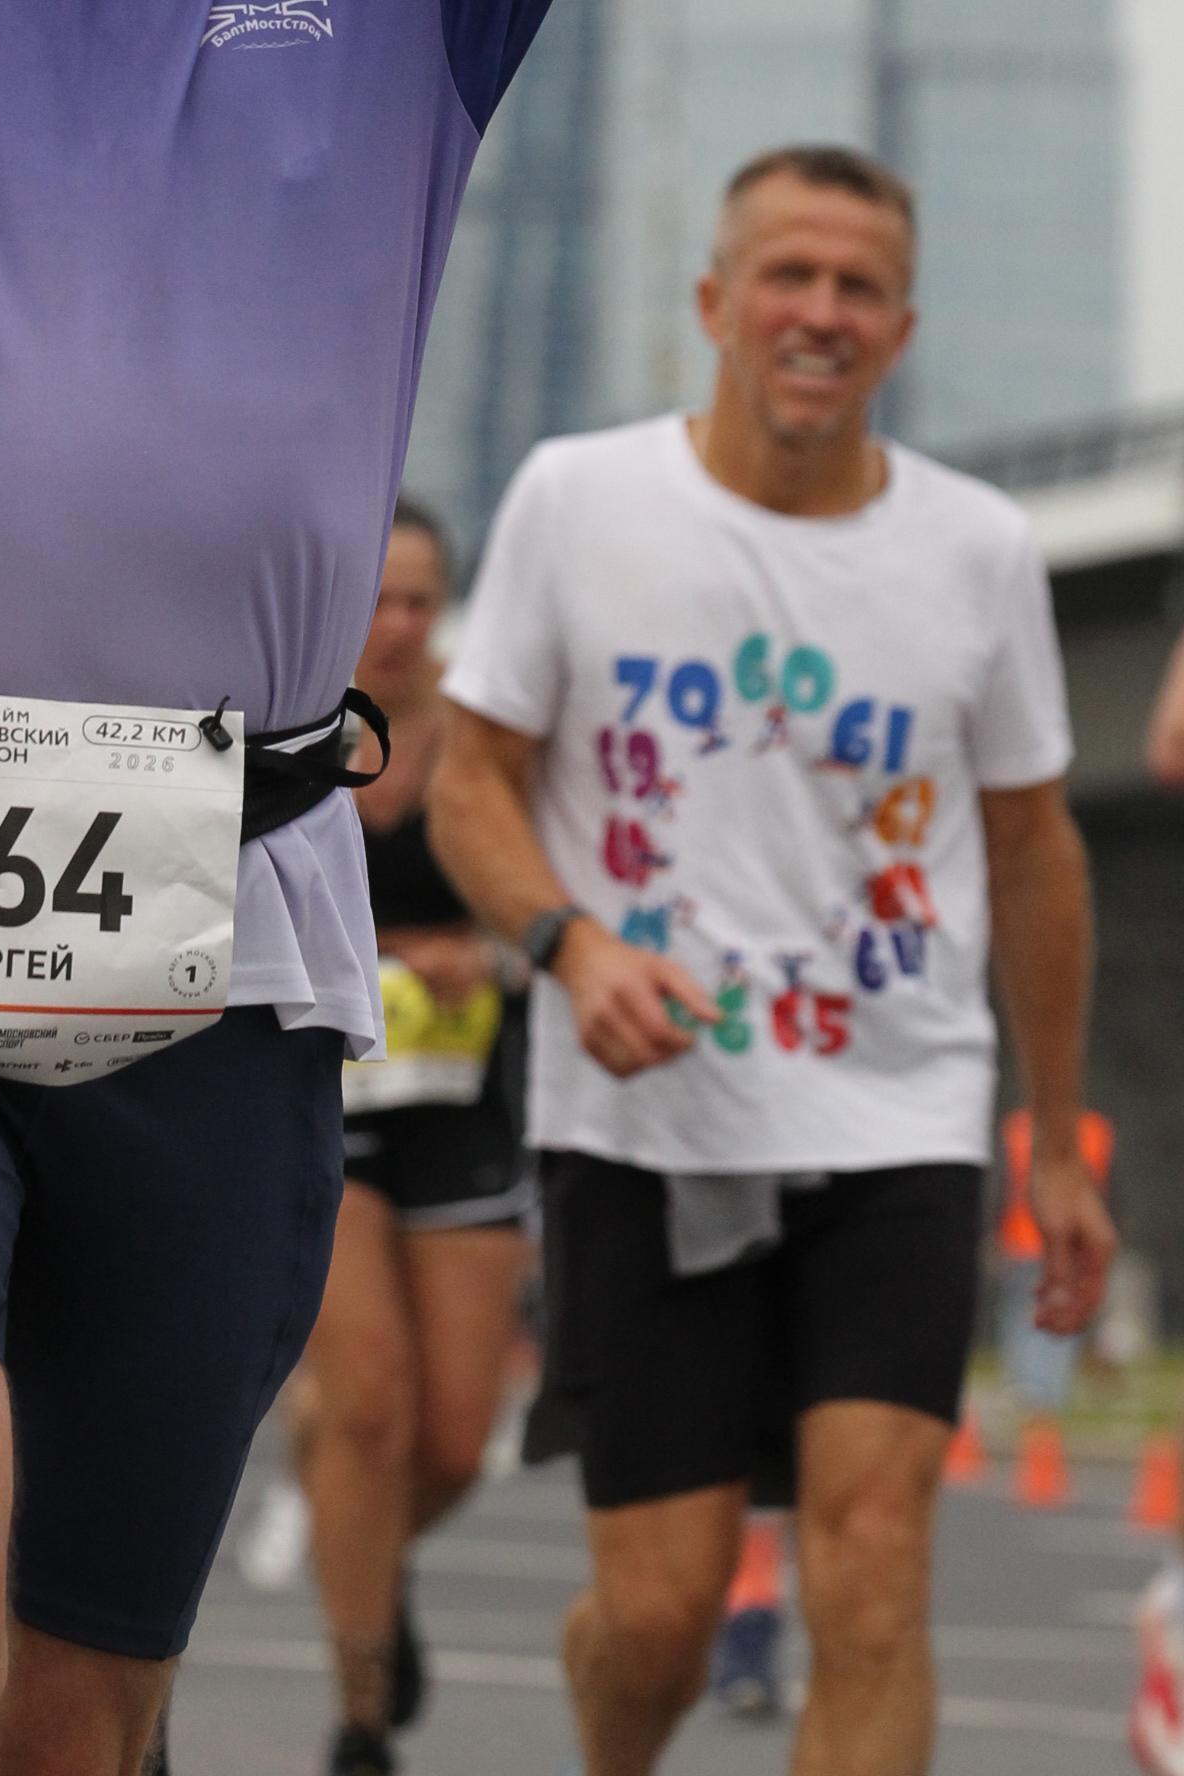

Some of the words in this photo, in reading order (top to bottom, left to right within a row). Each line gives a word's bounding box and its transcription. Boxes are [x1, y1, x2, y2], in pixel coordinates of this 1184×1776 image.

[733, 632, 836, 714] 60
[95, 722, 143, 742] 42,2
[152, 725, 187, 744] КМ
[108, 751, 175, 773] 2026
[185, 965, 197, 983] 1
[94, 1033, 130, 1043] СБЕР
